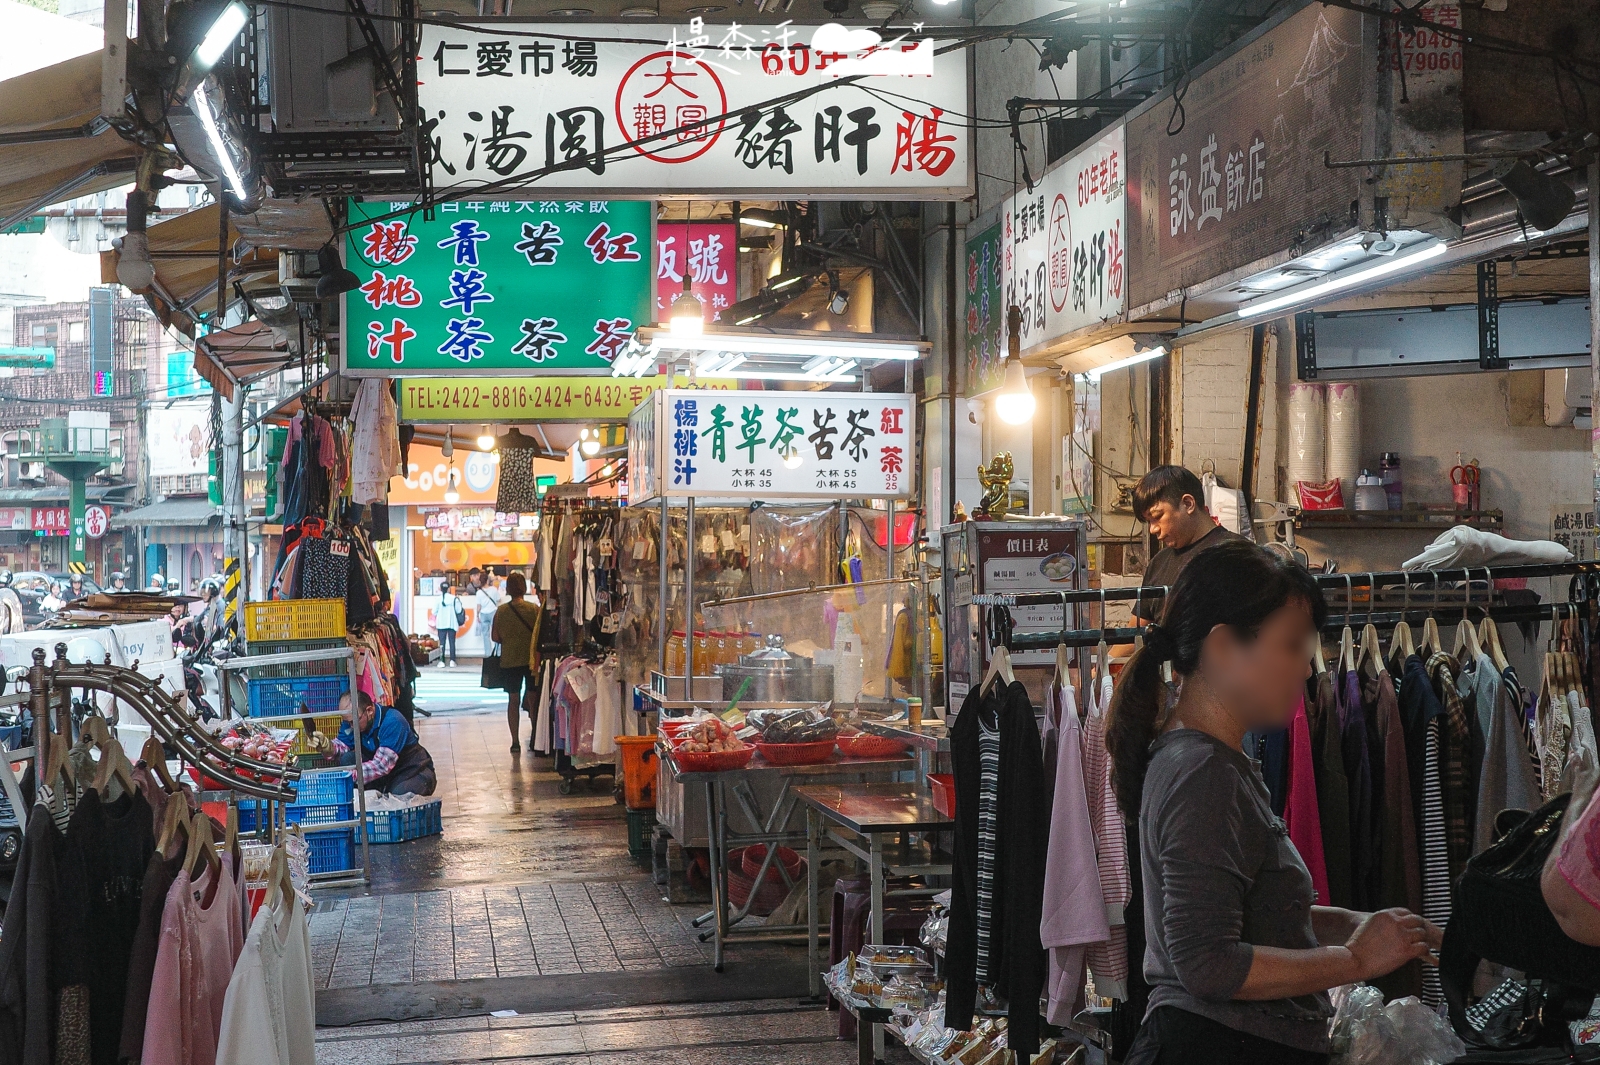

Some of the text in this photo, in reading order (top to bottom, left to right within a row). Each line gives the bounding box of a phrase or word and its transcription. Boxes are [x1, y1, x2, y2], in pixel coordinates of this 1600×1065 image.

[433, 40, 598, 77] 仁愛市場
[1168, 133, 1266, 238] 詠盛餅店
[361, 221, 423, 364] 楊桃汁
[437, 220, 495, 362] 青草茶
[511, 222, 568, 362] 苦茶
[674, 399, 698, 486] 楊桃汁
[701, 403, 805, 464] 青草茶
[807, 407, 876, 463] 苦茶
[880, 407, 904, 473] 紅茶
[403, 463, 462, 492] CoCo
[731, 469, 773, 478] 大杯 45
[731, 479, 772, 488] 小杯 35
[815, 469, 857, 478] 大杯 55
[815, 479, 857, 489] 小杯 45
[885, 474, 898, 482] 35
[885, 482, 898, 490] 25
[35, 509, 71, 528] 萬國優
[88, 509, 103, 535] 當
[1554, 512, 1594, 530] 鹹湯圓
[332, 542, 350, 554] 100
[1006, 538, 1049, 553] 價目表
